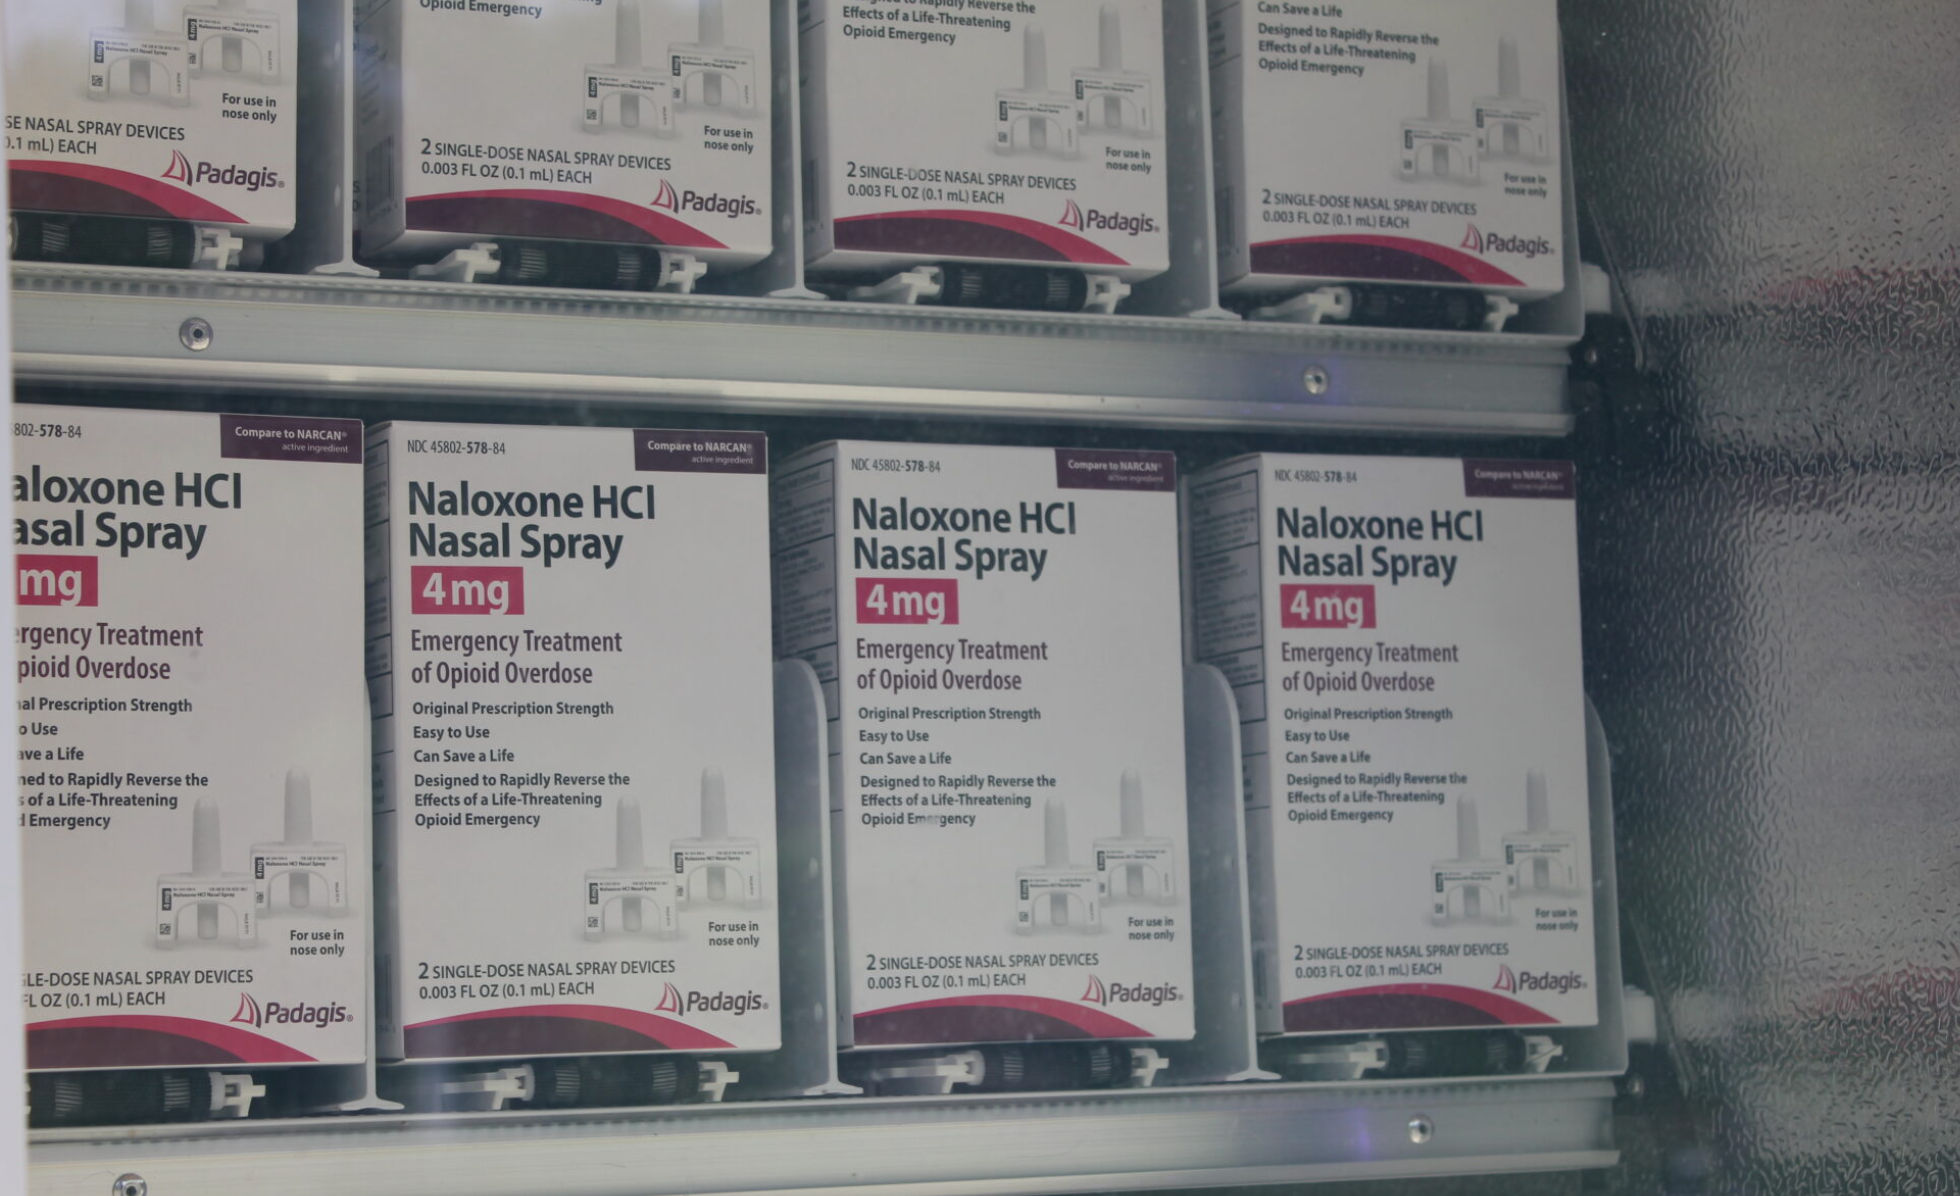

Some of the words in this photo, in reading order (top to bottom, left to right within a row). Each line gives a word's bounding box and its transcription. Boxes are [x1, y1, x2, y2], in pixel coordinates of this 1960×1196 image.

[1258, 56, 1298, 72] Opioid
[1300, 59, 1365, 77] Emergency
[222, 92, 241, 105] For
[243, 96, 263, 107] use
[265, 95, 276, 108] in
[221, 109, 249, 120] nose
[251, 109, 277, 124] only
[24, 116, 74, 133] NASAL
[77, 119, 123, 136] SPRAY
[125, 123, 185, 141] DEVICES
[703, 124, 721, 136] For
[722, 128, 741, 138] use
[742, 127, 753, 139] in
[420, 137, 431, 155] 2
[434, 142, 524, 161] SINGLE-DOSE
[526, 148, 571, 164] NASAL
[573, 151, 615, 166] SPRAY
[617, 154, 671, 171] DEVICES
[703, 140, 729, 151] nose
[730, 140, 754, 155] only
[420, 160, 458, 176] 0.003
[461, 162, 477, 177] FL
[479, 163, 499, 178] OZ
[502, 165, 524, 180] (0.1
[529, 167, 554, 183] mL)
[556, 168, 592, 184] EACH
[846, 160, 857, 178] 2
[859, 165, 942, 182] SINGLE-DOSE
[944, 170, 985, 185] NASAL
[987, 172, 1025, 187] SPRAY
[1027, 175, 1077, 191] DEVICES
[1261, 187, 1271, 205] 2
[1273, 192, 1350, 208] SINGLE-DOSE
[1352, 196, 1391, 211] NASAL
[1392, 198, 1428, 212] SPRAY
[1430, 200, 1477, 216] DEVICES
[234, 426, 282, 439] Compare
[283, 428, 295, 439] to
[281, 442, 306, 451] active
[307, 443, 348, 454] ingredient
[406, 438, 428, 453] NDC
[429, 440, 506, 455] 45802-578-84
[646, 439, 692, 452] Compare
[692, 442, 704, 452] to
[690, 455, 714, 463] active
[714, 453, 754, 465] ingredient
[850, 457, 870, 471] NDC
[871, 458, 941, 472] 45802-578-84
[174, 471, 241, 509] HCl
[408, 480, 584, 518] Naloxone
[592, 484, 655, 520] HCl
[852, 497, 1012, 532] Naloxone
[1019, 501, 1076, 535] HCl
[1276, 506, 1424, 540] Naloxone
[1430, 509, 1483, 542] HCl
[95, 511, 207, 560] Spray
[409, 522, 510, 558] Nasal
[520, 523, 624, 569] Spray
[853, 536, 946, 571] Nasal
[954, 538, 1049, 581] Spray
[1277, 545, 1364, 578] Nasal
[1372, 546, 1458, 587] Spray
[95, 622, 203, 646] Treatment
[410, 629, 519, 657] Emergency
[522, 629, 622, 652] Treatment
[856, 637, 955, 664] Emergency
[957, 638, 1048, 660] Treatment
[1280, 641, 1373, 667] Emergency
[1374, 641, 1459, 663] Treatment
[75, 655, 171, 679] Overdose
[410, 660, 433, 684] of
[435, 661, 500, 689] Opioid
[504, 661, 593, 684] Overdose
[856, 667, 876, 690] of
[879, 668, 938, 694] Opioid
[941, 668, 1022, 690] Overdose
[38, 696, 127, 714] Prescription
[130, 697, 192, 715] Strength
[412, 700, 468, 718] Original
[471, 701, 553, 717] Prescription
[555, 701, 614, 718] Strength
[413, 725, 445, 742] Easy
[446, 726, 462, 739] to
[464, 725, 490, 739] Use
[413, 748, 440, 763] Can
[442, 748, 475, 762] Save
[478, 751, 486, 762] a
[489, 747, 515, 762] Life
[48, 773, 64, 786] to
[67, 771, 123, 789] Rapidly
[126, 772, 182, 786] Reverse
[184, 772, 209, 786] the
[413, 772, 479, 790] Designed
[481, 774, 497, 786] to
[499, 772, 551, 789] Rapidly
[553, 772, 605, 786] Reverse
[607, 772, 630, 785] the
[414, 792, 461, 807] Effects
[462, 791, 478, 806] of
[480, 795, 489, 806] a
[491, 791, 602, 808] Life-Threatening
[414, 812, 462, 829] Opioid
[464, 812, 540, 828] Emergency
[708, 920, 726, 932] For
[727, 922, 747, 932] use
[748, 920, 759, 933] in
[708, 937, 734, 946] nose
[735, 933, 760, 948] only
[93, 970, 142, 986] NASAL
[145, 970, 191, 985] SPRAY
[194, 968, 253, 984] DEVICES
[417, 961, 429, 980] 2
[432, 963, 524, 979] SINGLE-DOSE
[527, 962, 573, 977] NASAL
[575, 961, 617, 975] SPRAY
[620, 959, 675, 974] DEVICES
[418, 984, 457, 1000] 0.003
[460, 984, 476, 998] FL
[478, 983, 499, 998] OZ
[502, 983, 525, 999] (0.1
[530, 982, 555, 997] mL)
[558, 981, 594, 996] EACH
